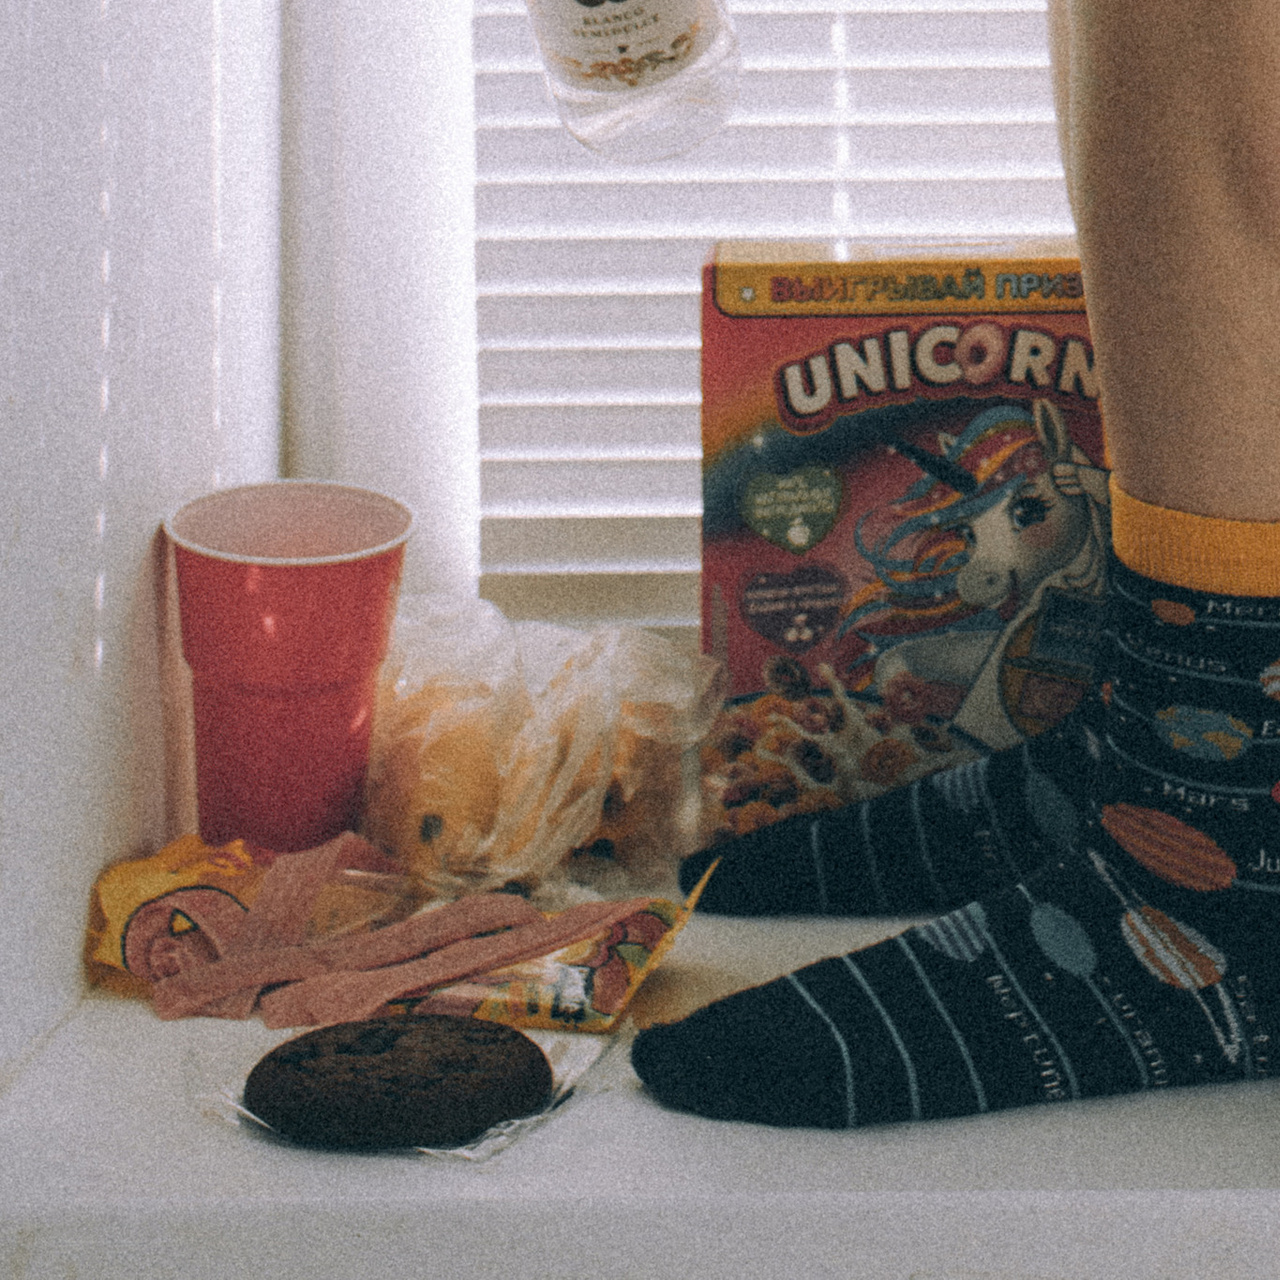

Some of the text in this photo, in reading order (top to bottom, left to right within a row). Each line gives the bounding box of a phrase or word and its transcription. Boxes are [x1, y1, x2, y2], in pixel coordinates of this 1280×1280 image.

[769, 267, 985, 303] ВЫИГРЫВАЙ
[784, 322, 1099, 416] UNICORN
[1163, 781, 1250, 813] Mars
